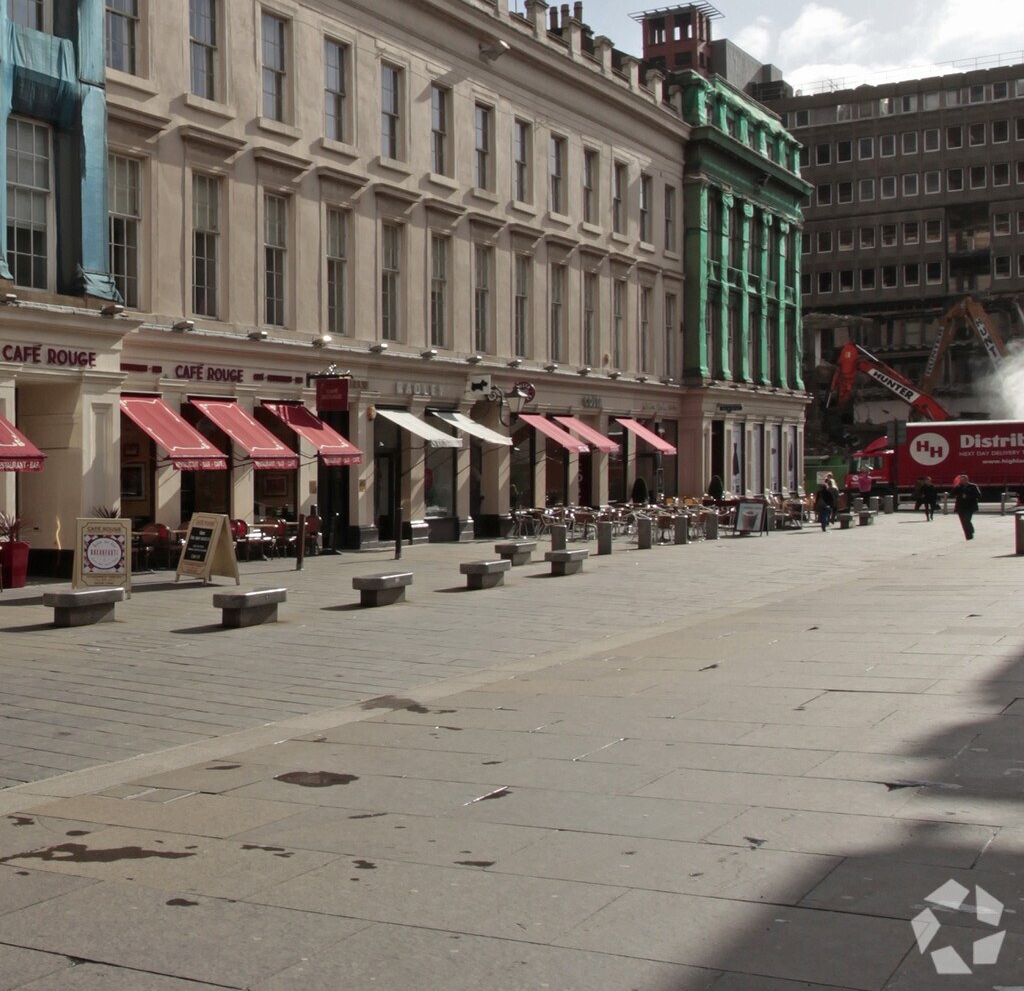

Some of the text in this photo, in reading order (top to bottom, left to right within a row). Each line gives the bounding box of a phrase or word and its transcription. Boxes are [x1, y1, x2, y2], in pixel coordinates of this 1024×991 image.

[1, 342, 97, 368] CAFÉ ROUGE
[175, 363, 205, 381] CAFÉ
[206, 366, 244, 383] ROUGE
[872, 370, 914, 400] HUNTER
